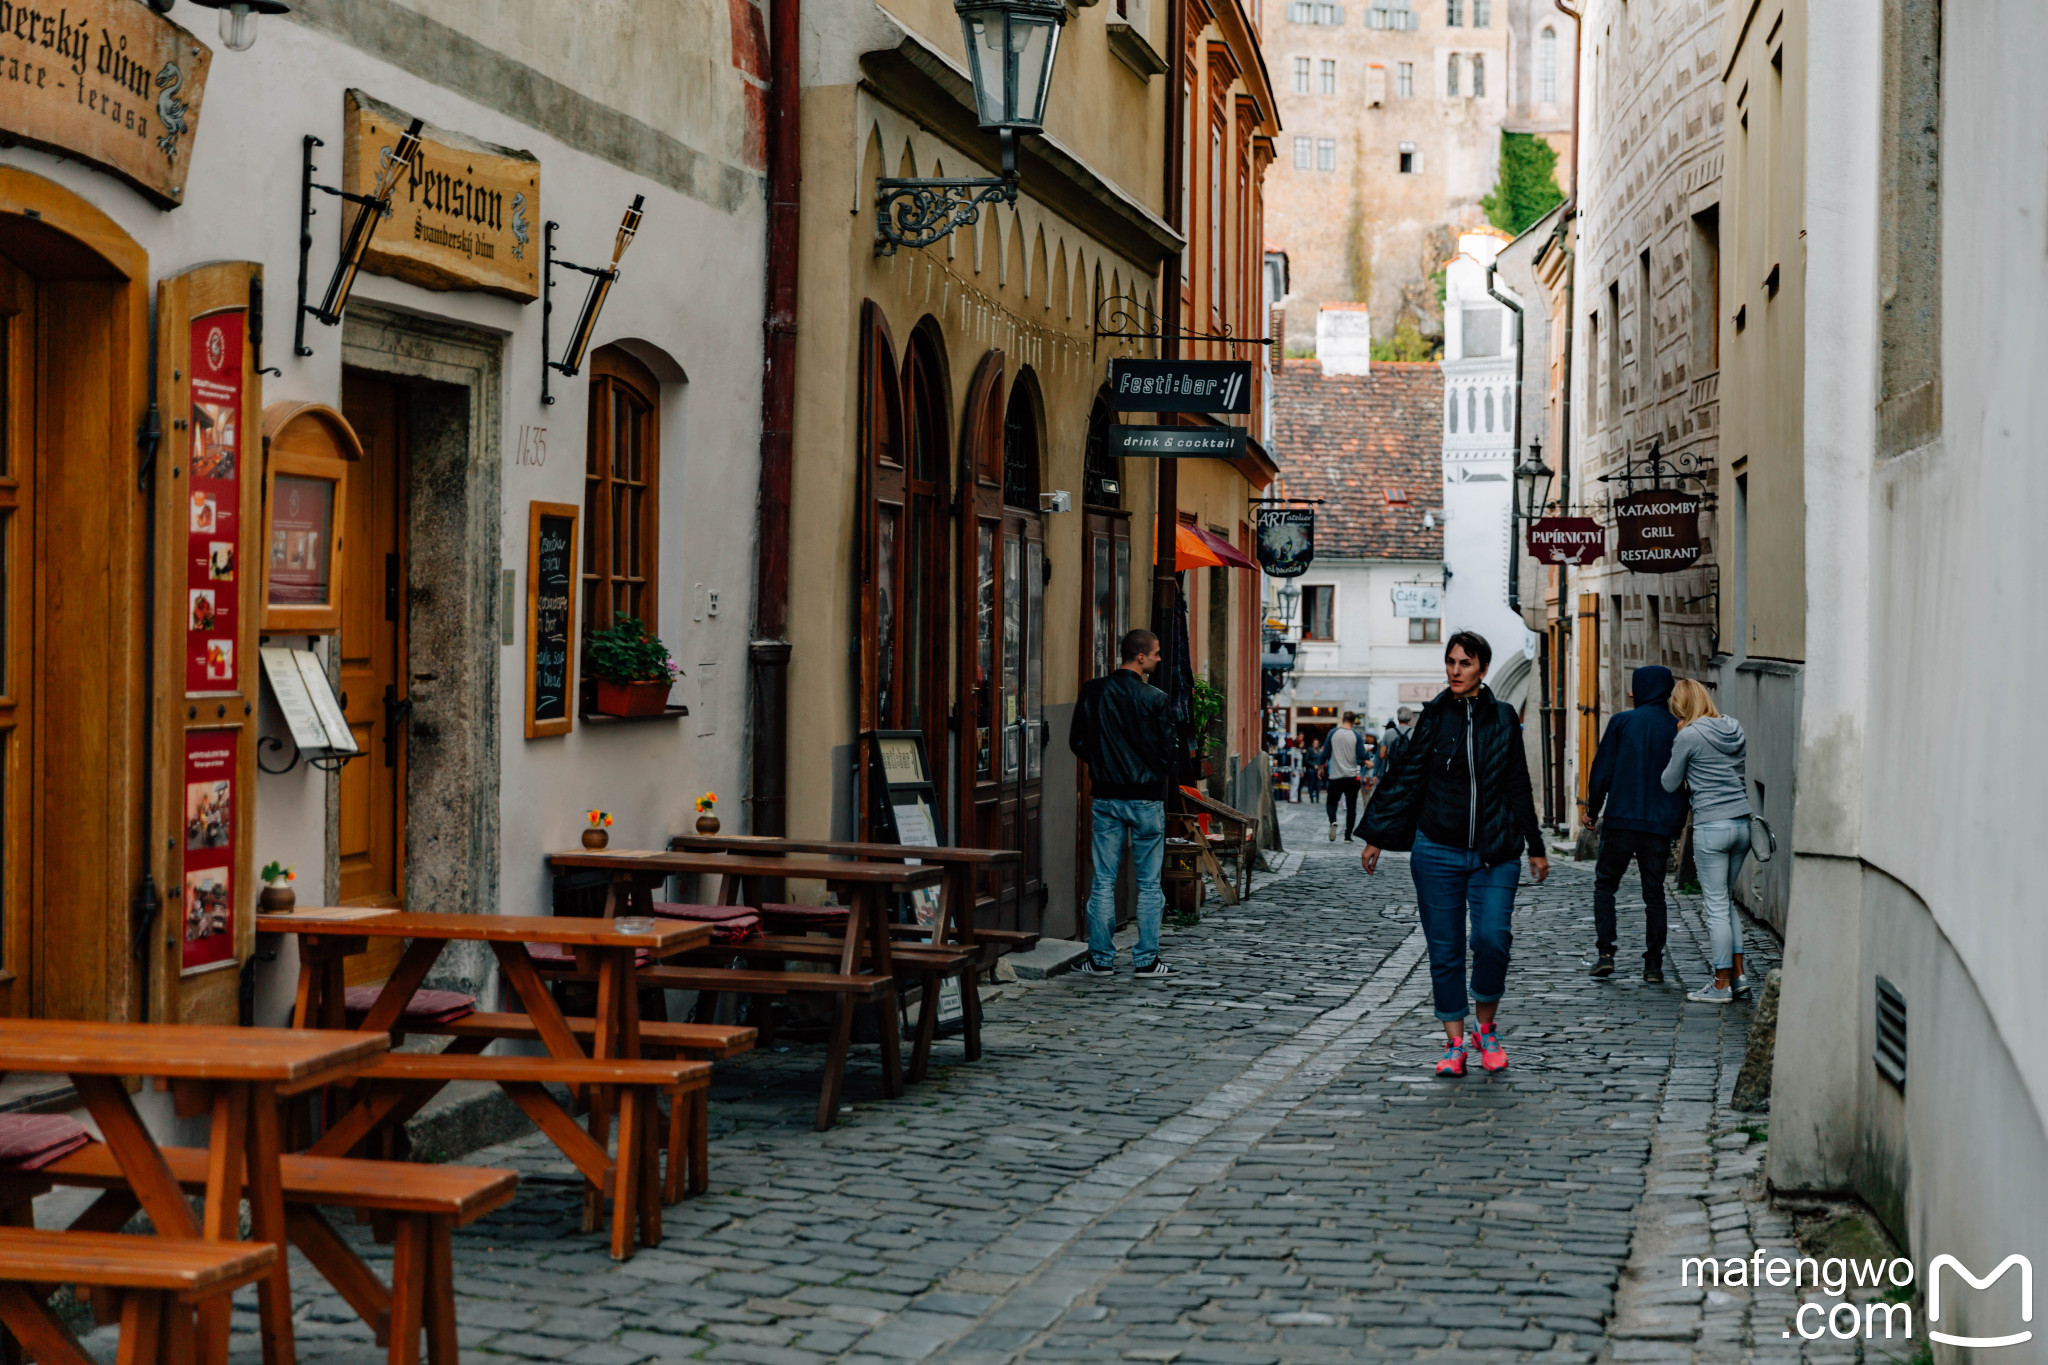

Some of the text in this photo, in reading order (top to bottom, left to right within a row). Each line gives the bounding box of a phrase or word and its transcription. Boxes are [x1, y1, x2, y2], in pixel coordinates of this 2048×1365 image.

[97, 28, 152, 100] dům
[77, 76, 148, 138] terasa
[408, 149, 502, 231] Pension
[475, 232, 495, 260] dům
[1123, 436, 1235, 448] drink & cocktail
[1617, 501, 1697, 517] KATAKOMBY
[1258, 511, 1290, 527] ART
[1532, 528, 1603, 544] PAPÍRNICTVÍ
[1641, 526, 1675, 538] GRILL
[1621, 547, 1698, 561] RESTAURANT
